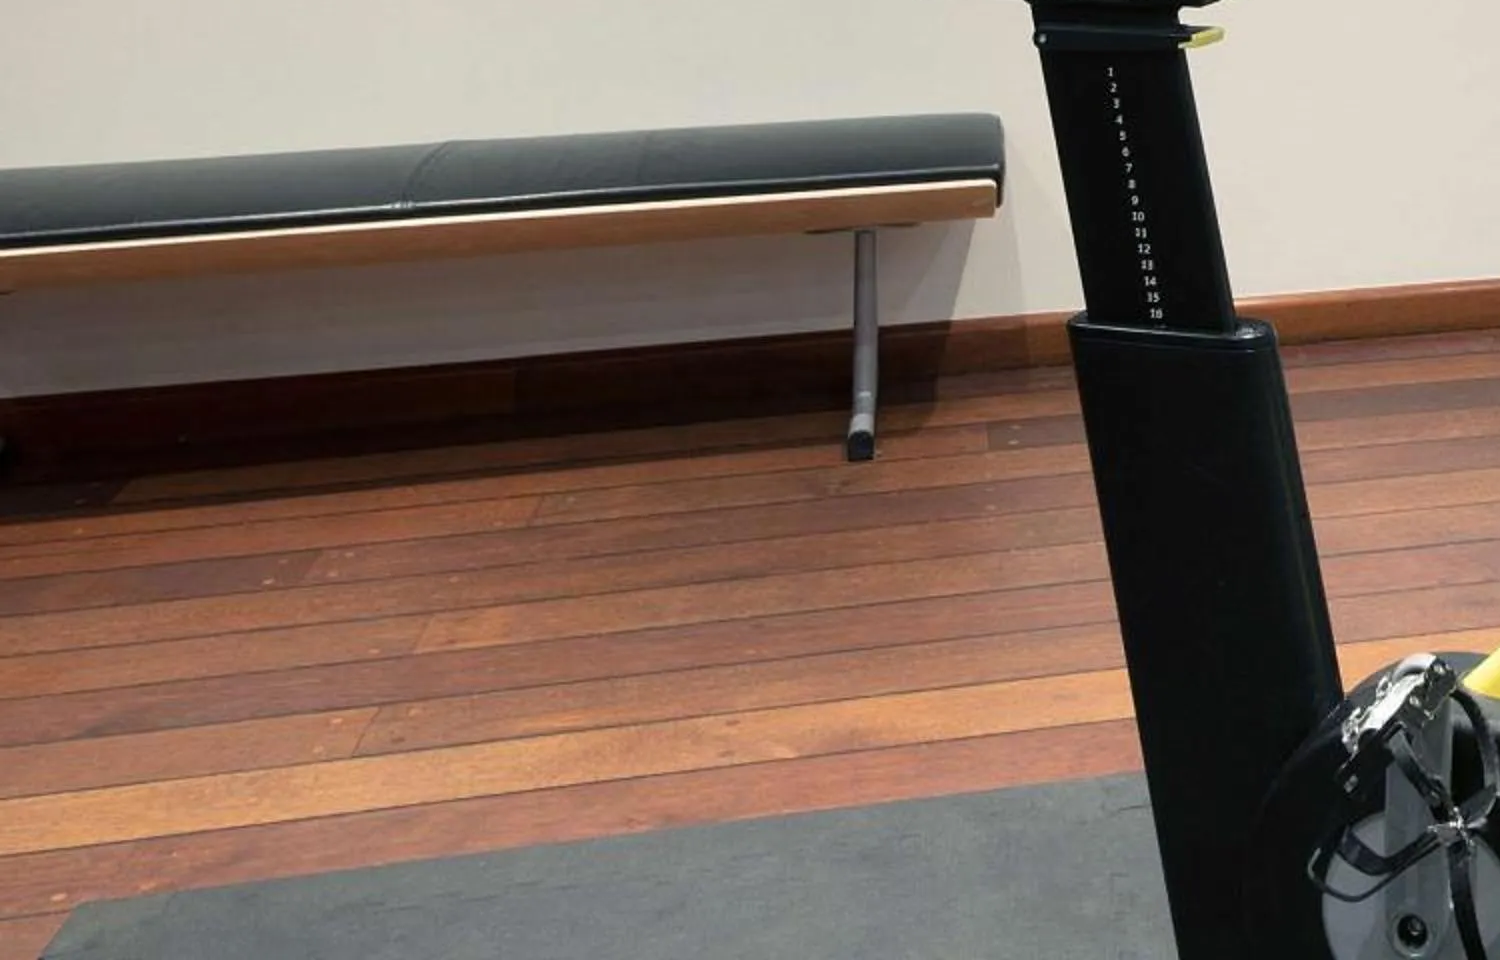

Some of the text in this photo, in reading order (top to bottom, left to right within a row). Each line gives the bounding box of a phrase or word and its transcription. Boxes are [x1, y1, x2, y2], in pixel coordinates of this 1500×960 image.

[1106, 66, 1114, 78] 1
[1109, 82, 1118, 93] 2
[1112, 97, 1120, 109] 3
[1114, 114, 1124, 125] 4
[1119, 130, 1127, 141] 5
[1121, 146, 1130, 158] 6
[1124, 162, 1133, 173] 7
[1127, 178, 1137, 190] 8
[1130, 195, 1140, 206] 9
[1131, 210, 1145, 222] 10
[1135, 227, 1148, 239] 11
[1137, 243, 1151, 255] 12
[1141, 259, 1154, 271] 13
[1143, 275, 1157, 287] 14
[1146, 291, 1161, 303] 15
[1149, 307, 1164, 319] 16
